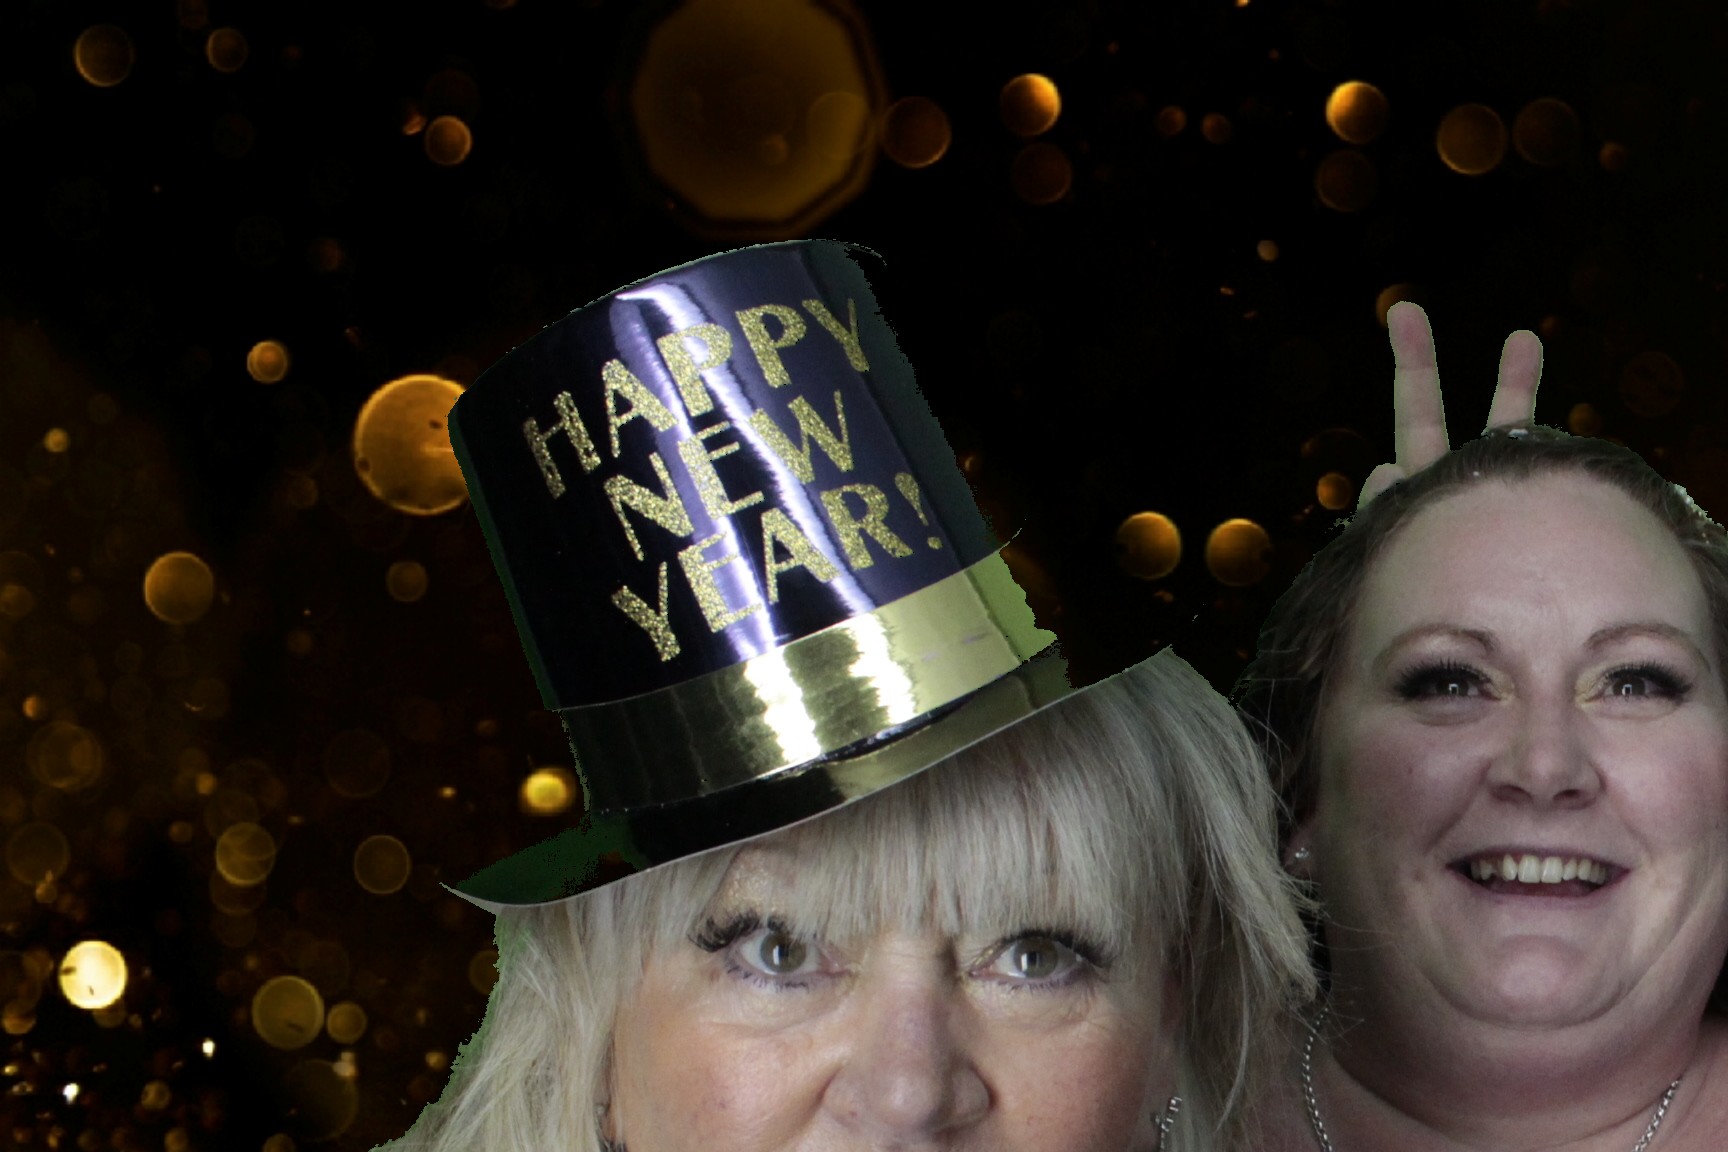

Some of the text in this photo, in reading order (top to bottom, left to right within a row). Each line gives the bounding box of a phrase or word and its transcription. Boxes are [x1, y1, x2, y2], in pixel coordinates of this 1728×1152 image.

[523, 299, 870, 498] HAPPY
[604, 391, 855, 561] NEW
[612, 472, 943, 661] YEAR!
